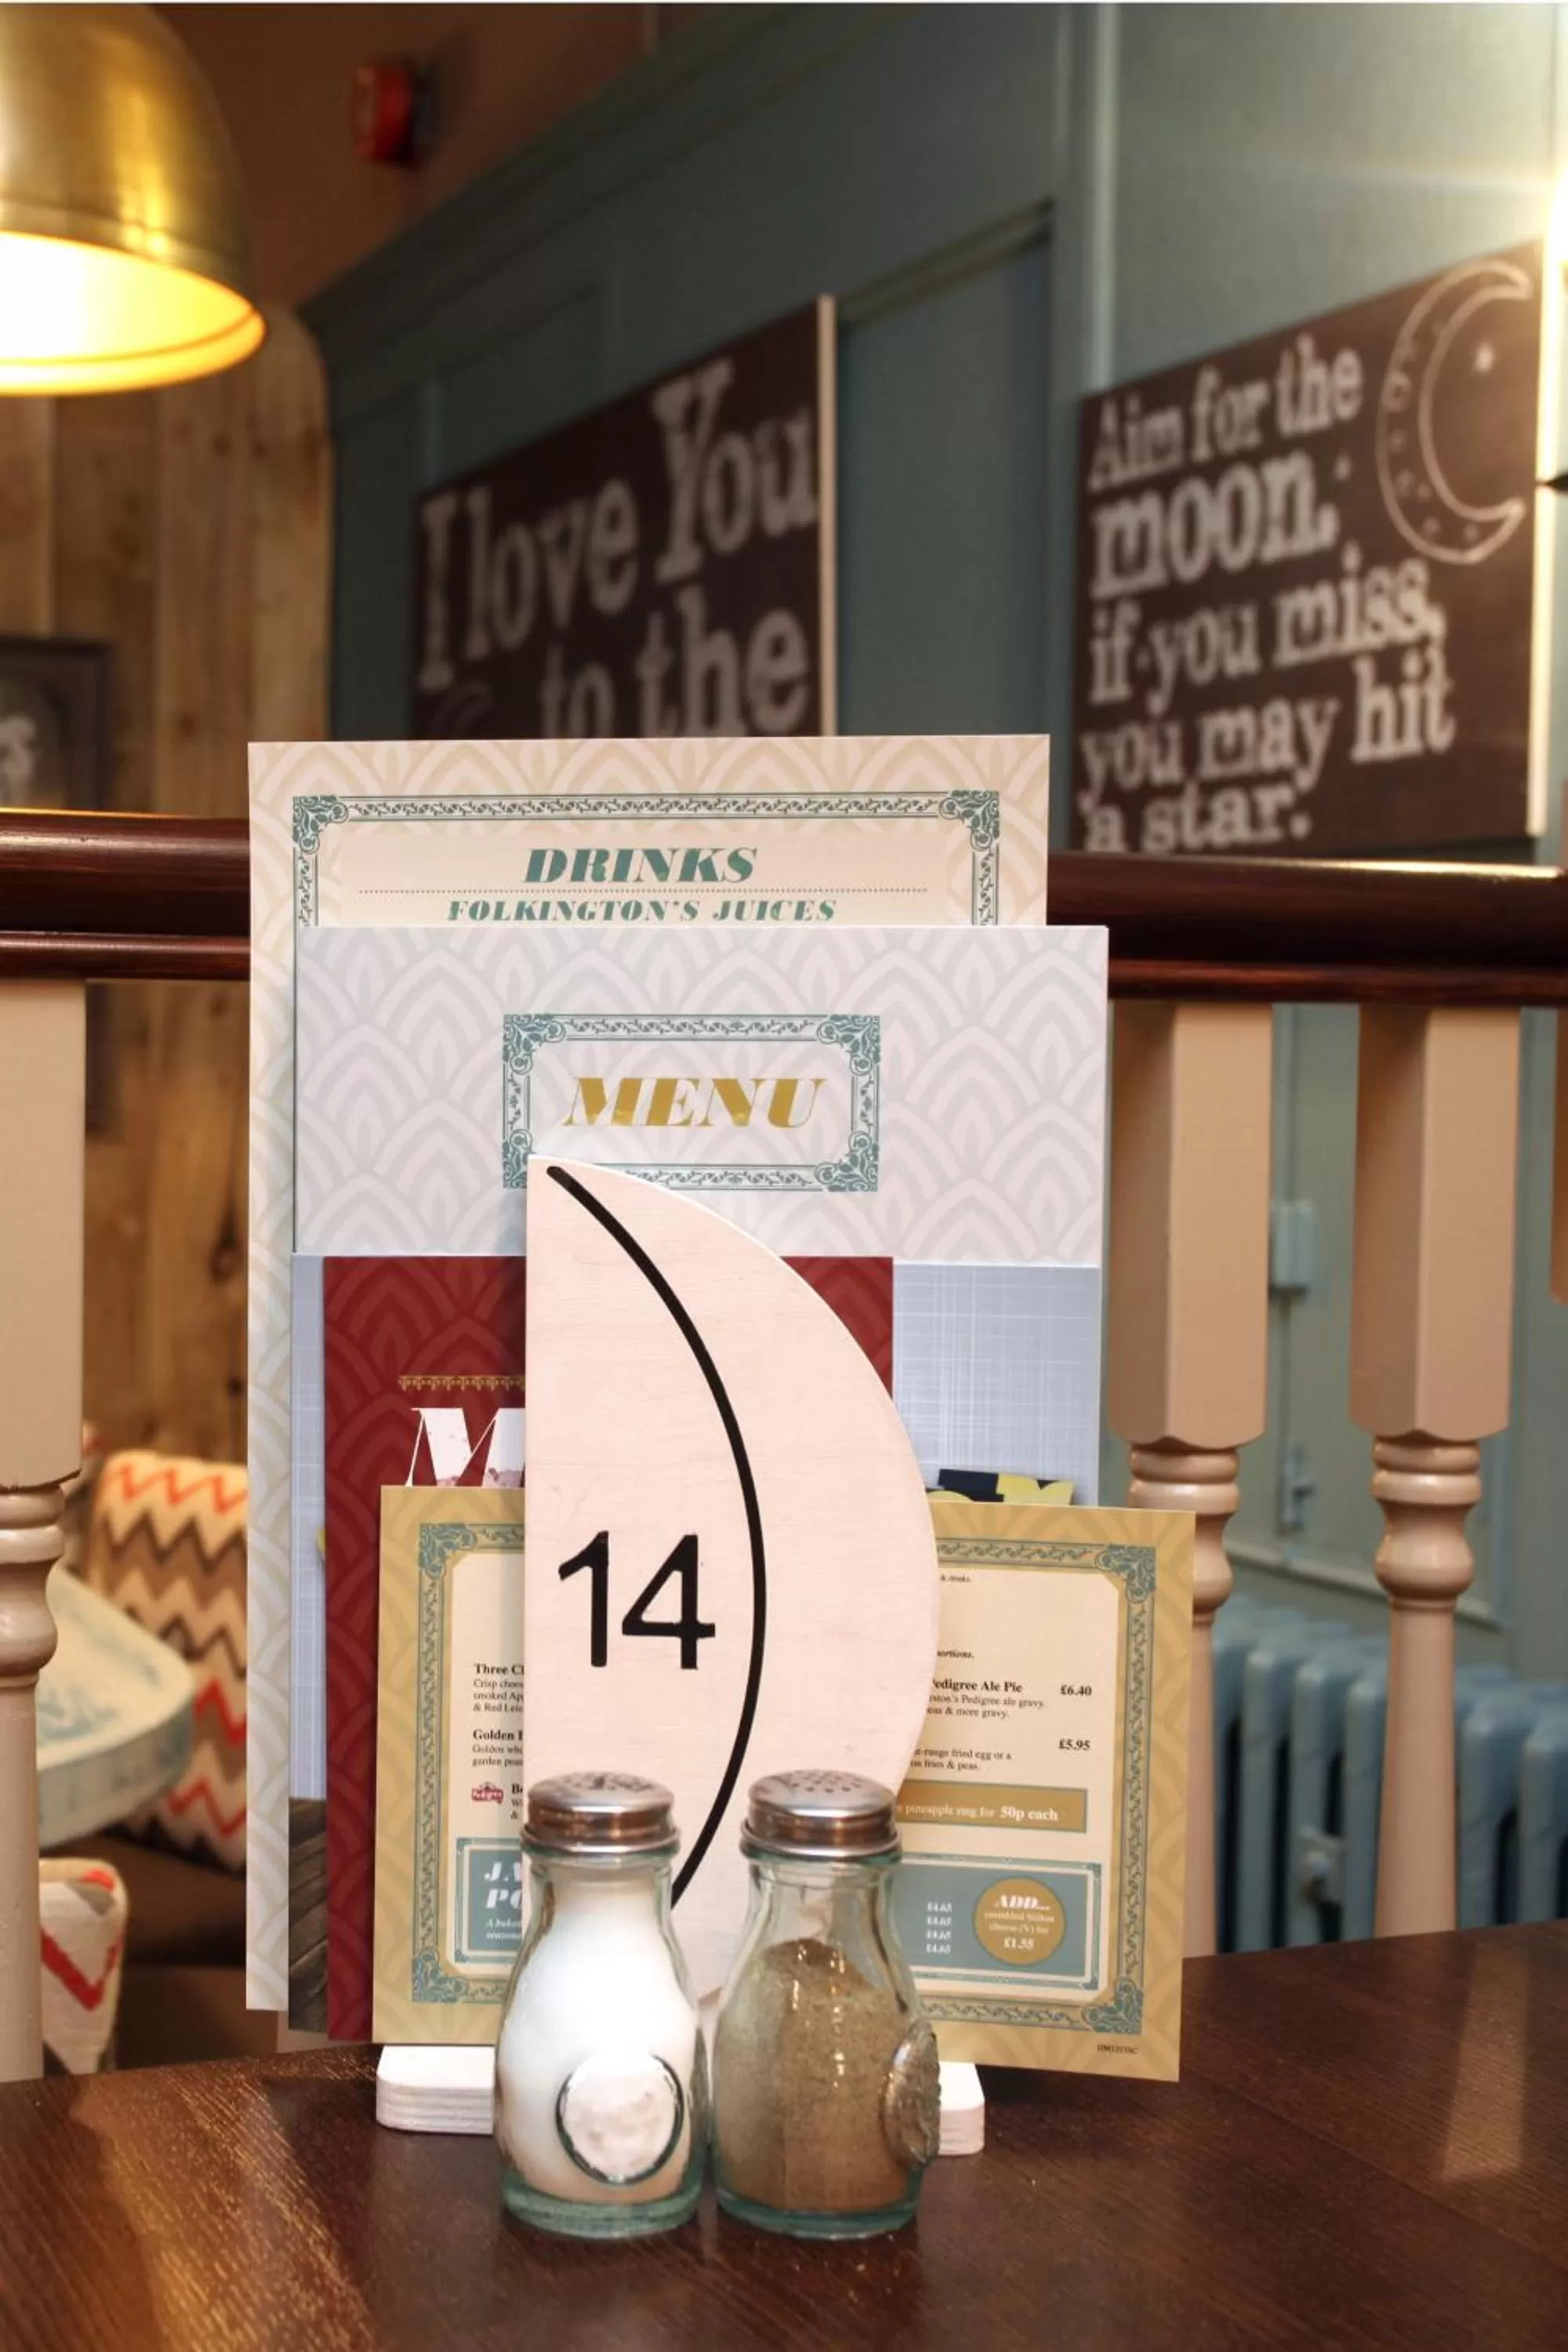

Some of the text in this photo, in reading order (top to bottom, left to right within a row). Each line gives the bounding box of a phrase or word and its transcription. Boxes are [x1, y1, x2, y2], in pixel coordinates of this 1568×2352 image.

[1087, 332, 1364, 492] Aim for the
[420, 357, 818, 693] I love You
[635, 582, 811, 737] the
[1089, 597, 1142, 706] if
[1145, 600, 1262, 717] you
[1077, 646, 1457, 814] you may hit
[1084, 779, 1313, 855] a star.
[522, 847, 758, 884] DRINKS
[447, 898, 837, 921] FOLKINGTON'S JUICES
[562, 1076, 829, 1129] MENU
[557, 1530, 716, 1670] 14
[473, 1663, 508, 1675] Three
[981, 1680, 1000, 1693] Ale
[1004, 1680, 1023, 1693] Pie
[1060, 1684, 1092, 1697] £6.40
[956, 1708, 978, 1717] more
[473, 1728, 515, 1741] Golden
[1058, 1738, 1091, 1751] £5.95
[947, 1759, 955, 1769] &
[951, 1748, 973, 1759] fried
[999, 1805, 1025, 1821] 50p
